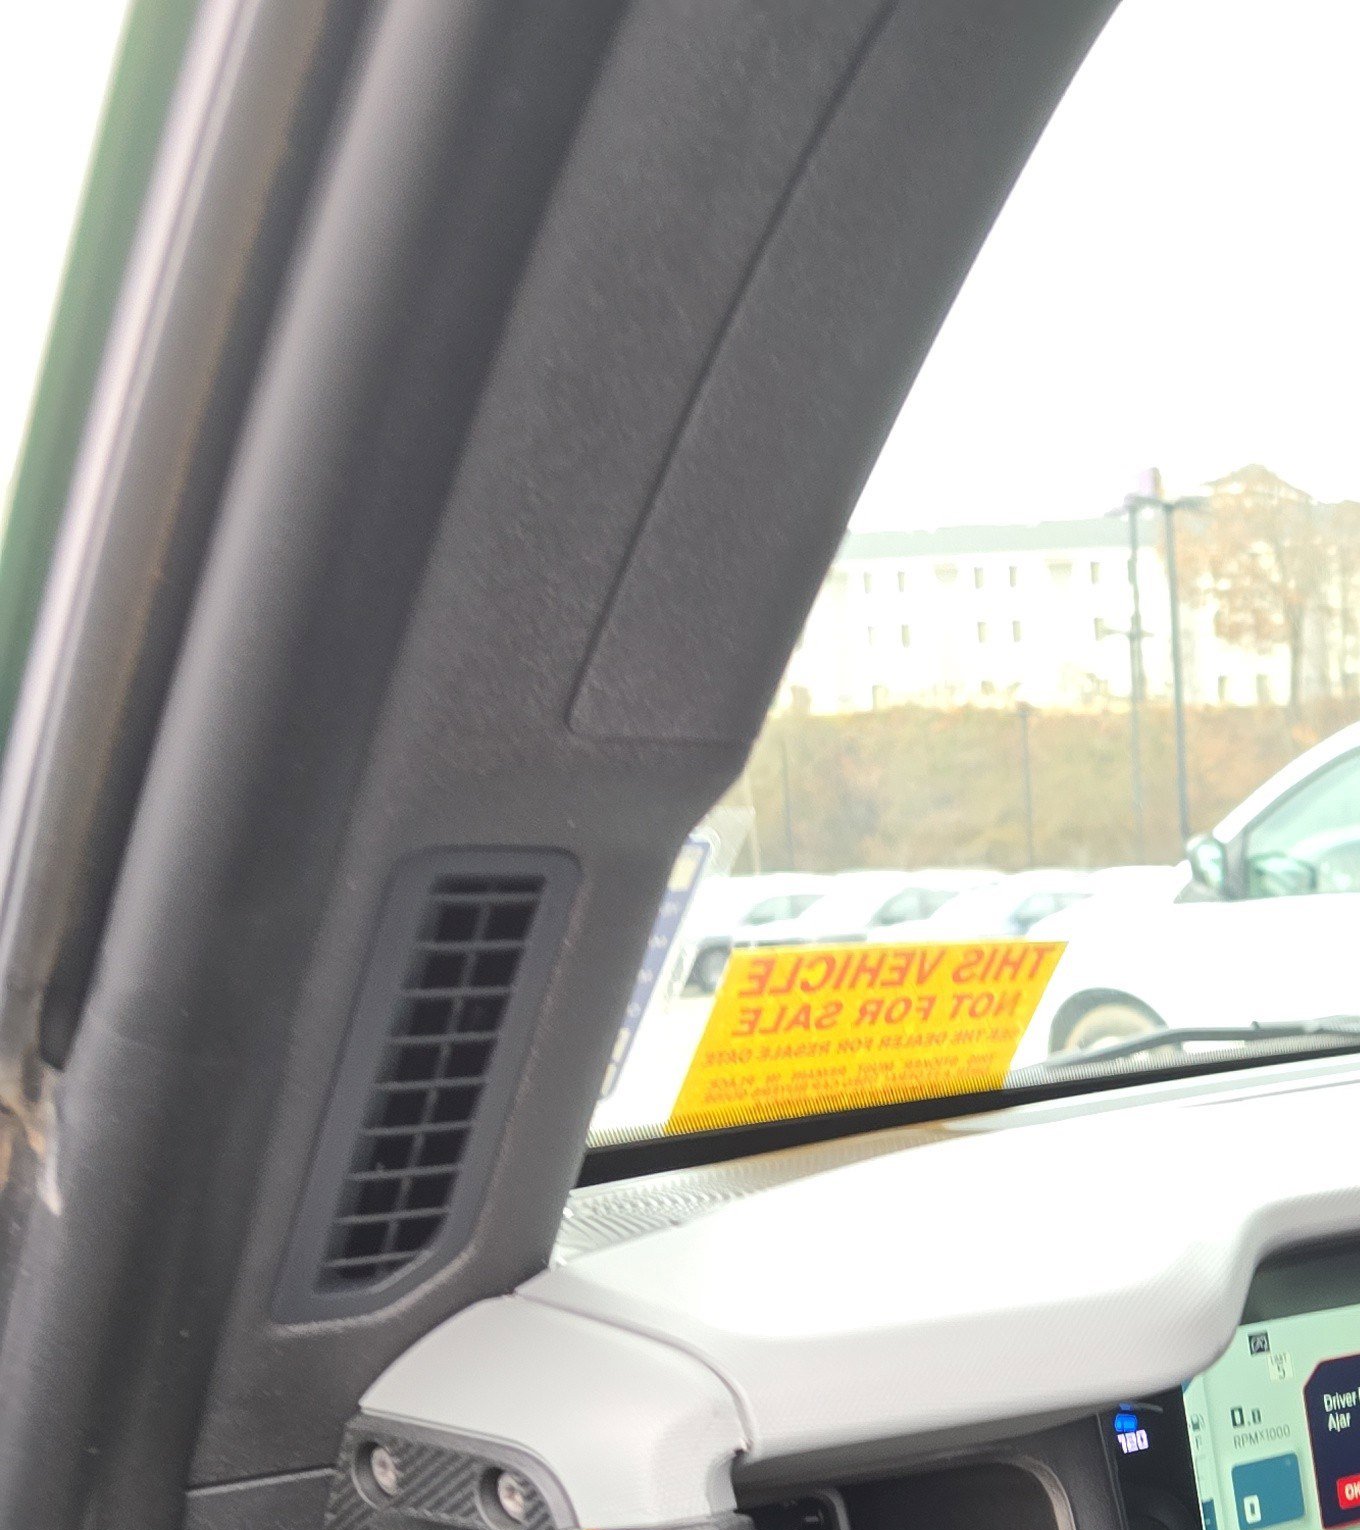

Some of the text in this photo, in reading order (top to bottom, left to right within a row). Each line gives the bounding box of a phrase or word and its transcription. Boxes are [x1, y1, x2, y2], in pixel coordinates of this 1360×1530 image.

[1323, 1391, 1357, 1412] Driver
[1327, 1411, 1351, 1433] Ajar
[1243, 1494, 1262, 1525] 0
